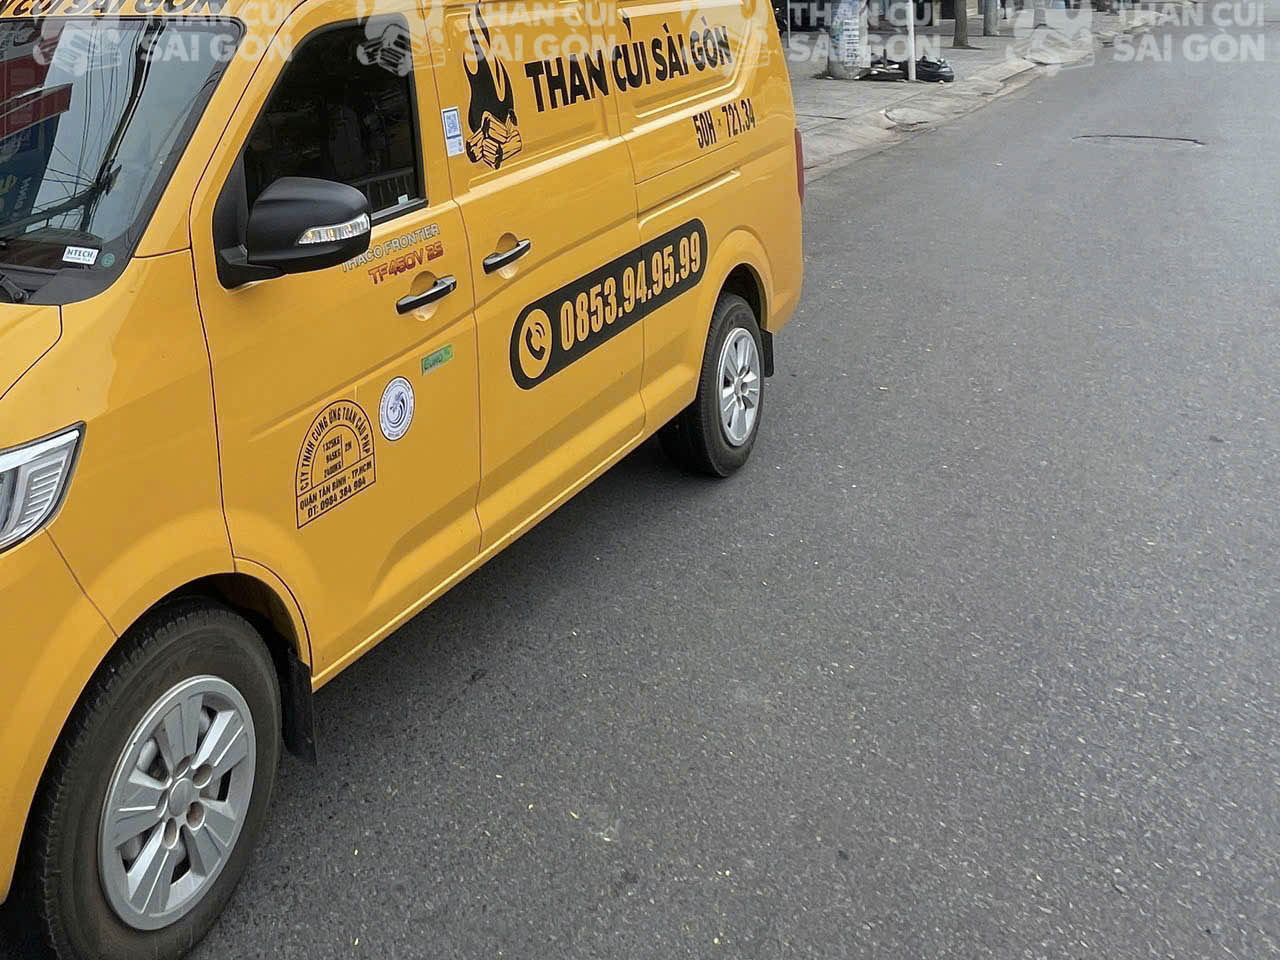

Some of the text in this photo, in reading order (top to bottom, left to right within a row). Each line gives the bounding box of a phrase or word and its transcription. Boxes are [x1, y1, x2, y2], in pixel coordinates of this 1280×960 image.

[524, 48, 609, 113] THAN
[693, 98, 757, 149] 50H 721.34
[341, 223, 441, 273] THACO FRONTIER
[559, 230, 704, 352] 0853.94.95.99
[301, 440, 315, 468] TNHH
[311, 416, 329, 441] CUNG
